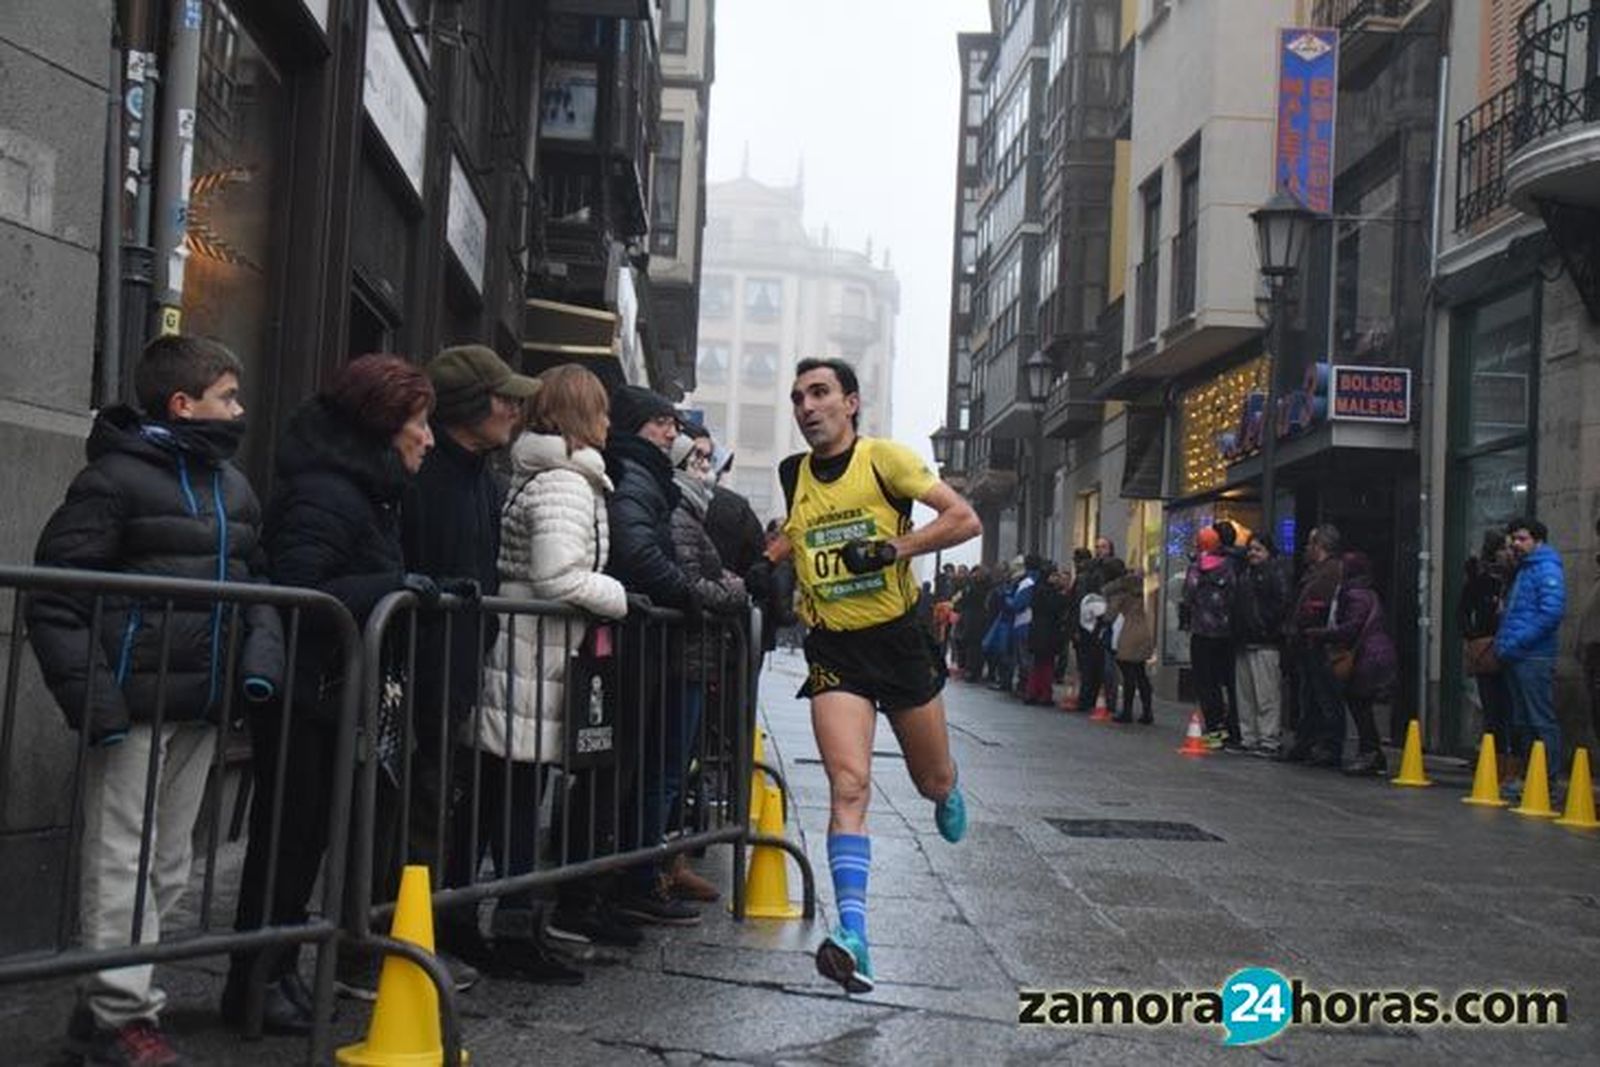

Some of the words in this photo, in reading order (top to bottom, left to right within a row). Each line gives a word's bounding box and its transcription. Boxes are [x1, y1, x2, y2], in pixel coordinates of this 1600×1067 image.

[1280, 79, 1303, 194] MALETA
[1309, 79, 1332, 213] BOLSOS
[1340, 374, 1402, 391] BOLSOS
[1337, 398, 1405, 415] MALETAS
[814, 547, 844, 579] 07
